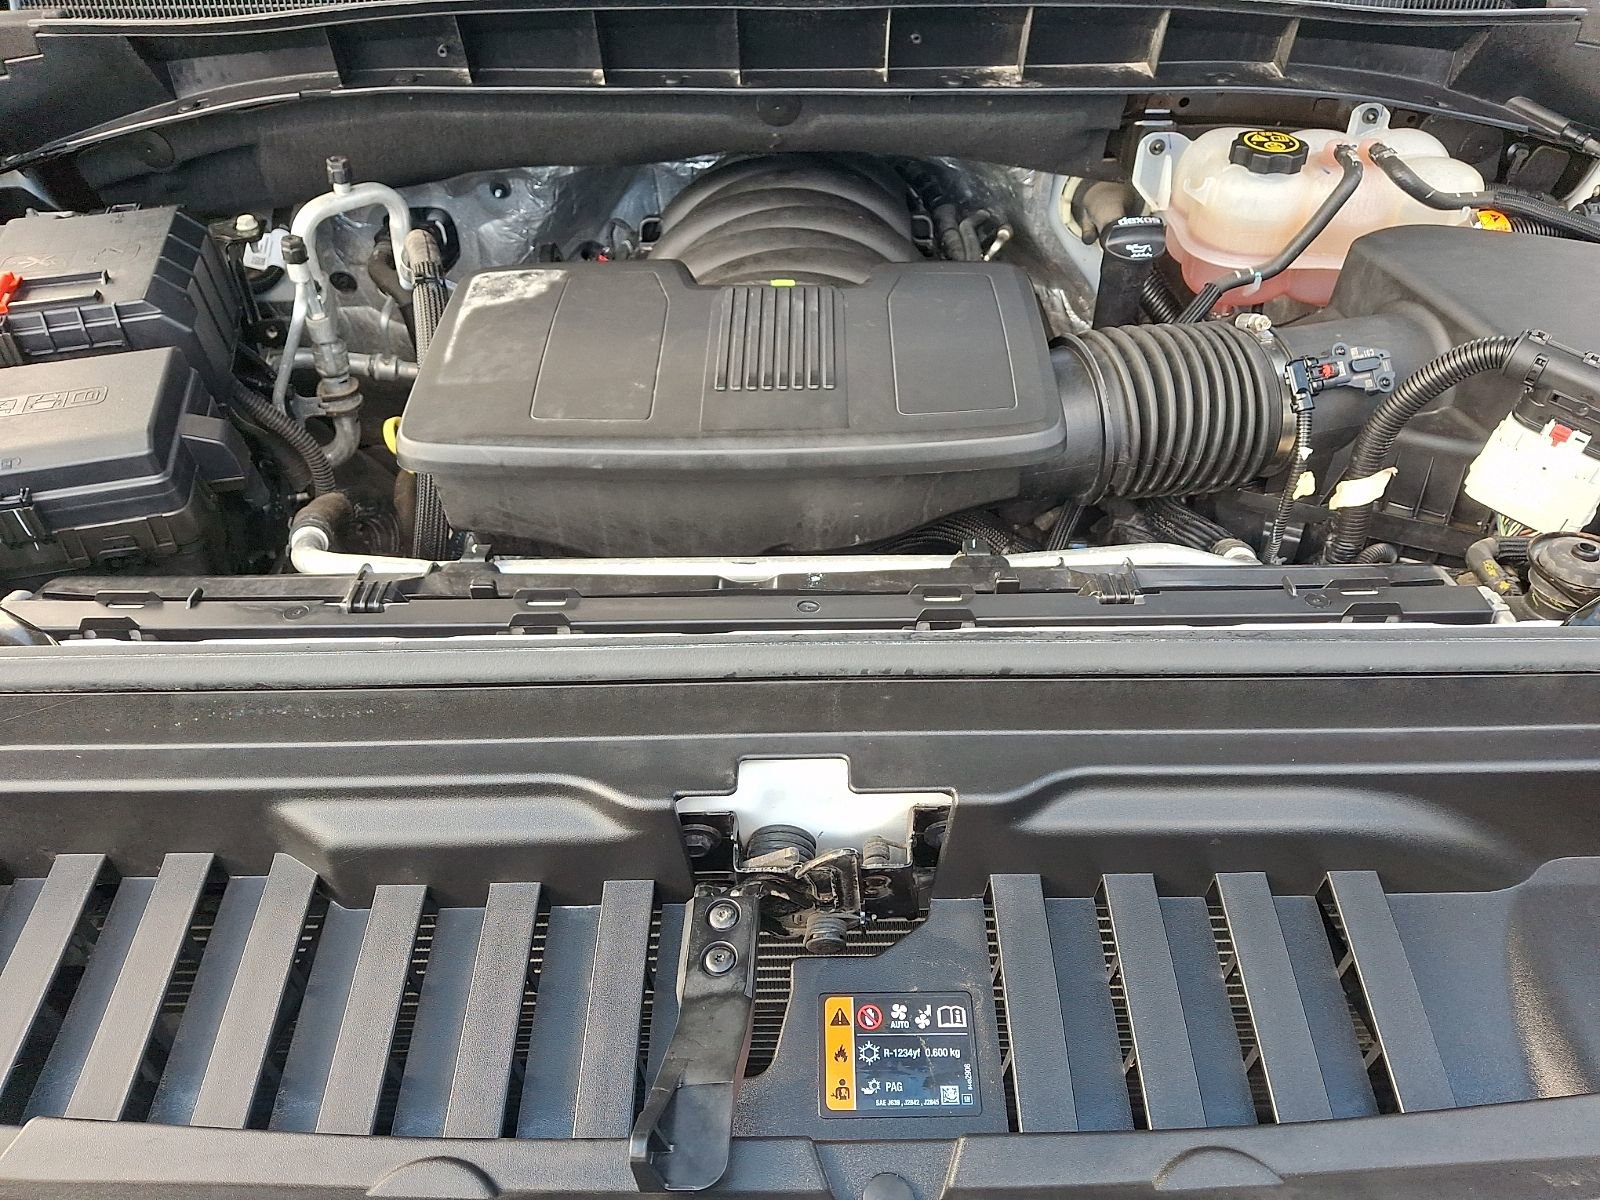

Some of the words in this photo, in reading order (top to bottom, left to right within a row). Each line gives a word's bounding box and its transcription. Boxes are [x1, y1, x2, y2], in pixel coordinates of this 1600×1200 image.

[890, 1020, 910, 1028] AUTO
[884, 1048, 920, 1059] R-1234yf
[924, 1048, 948, 1058] 0.600
[950, 1048, 960, 1058] kg
[886, 1081, 903, 1092] PAG
